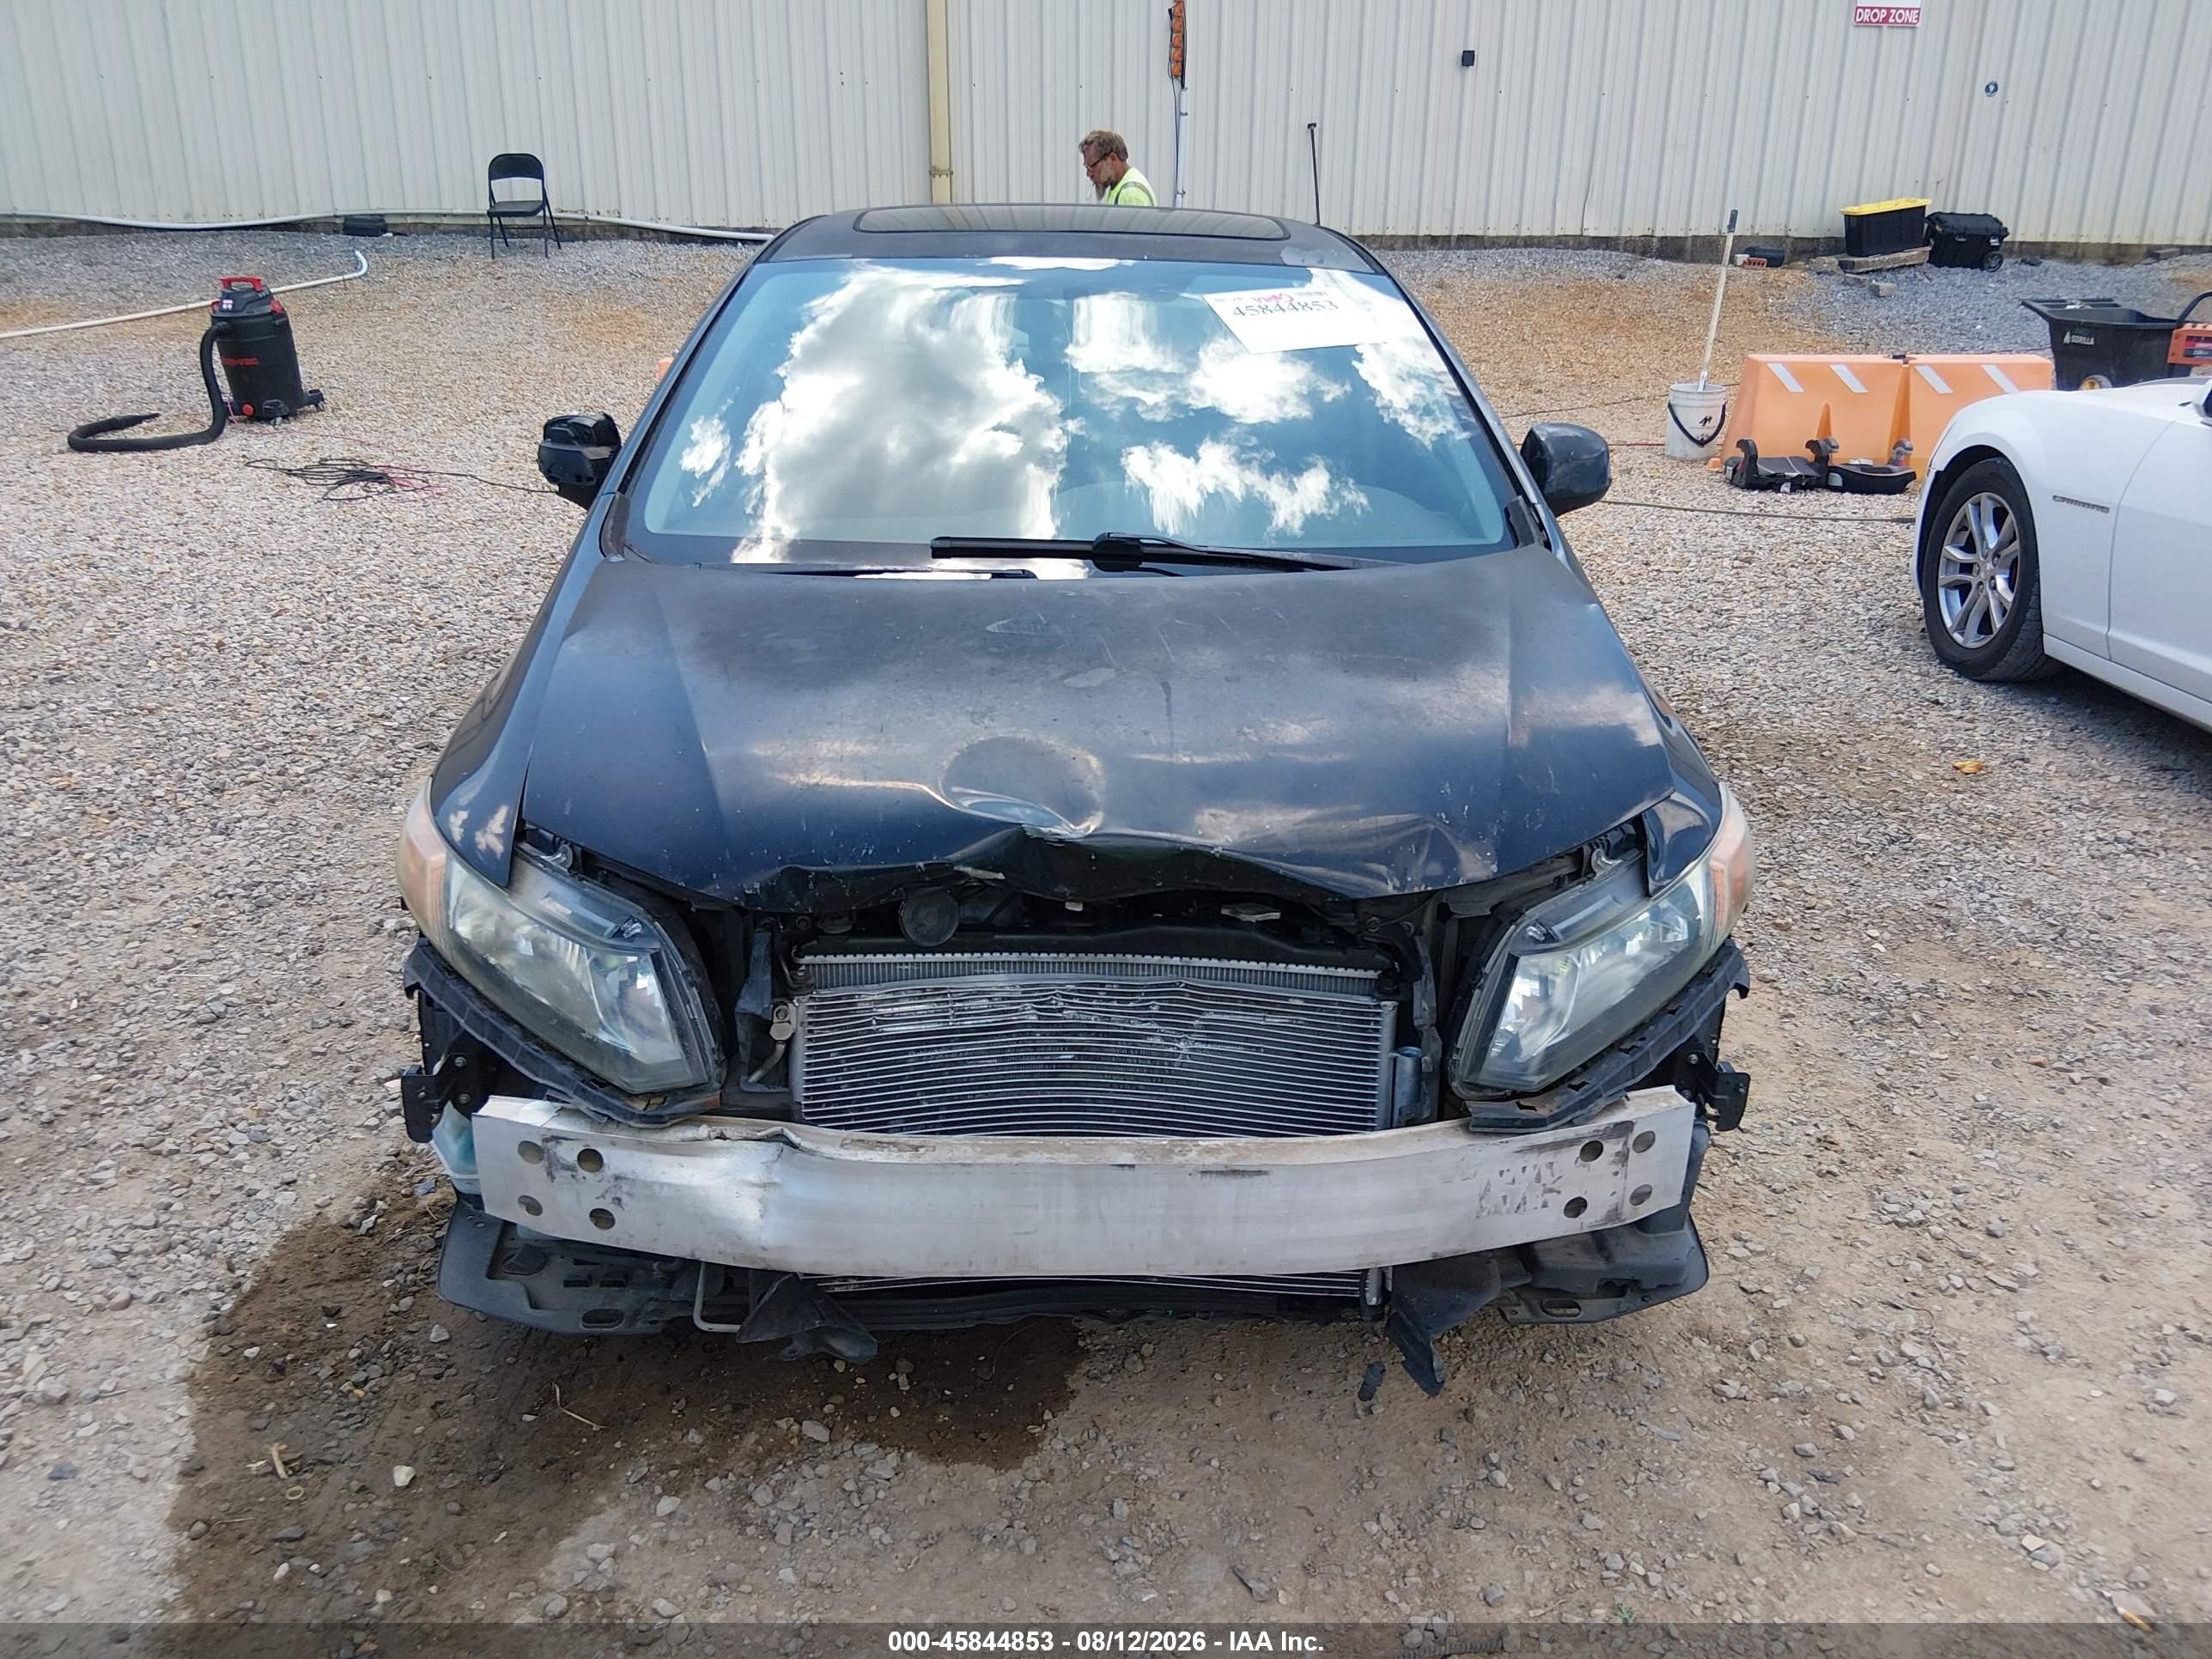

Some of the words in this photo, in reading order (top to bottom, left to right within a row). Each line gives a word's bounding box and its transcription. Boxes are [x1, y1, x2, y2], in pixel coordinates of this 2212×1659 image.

[1856, 8, 1887, 22] DROP
[1888, 9, 1919, 23] ZONE
[1232, 300, 1339, 317] 45844853
